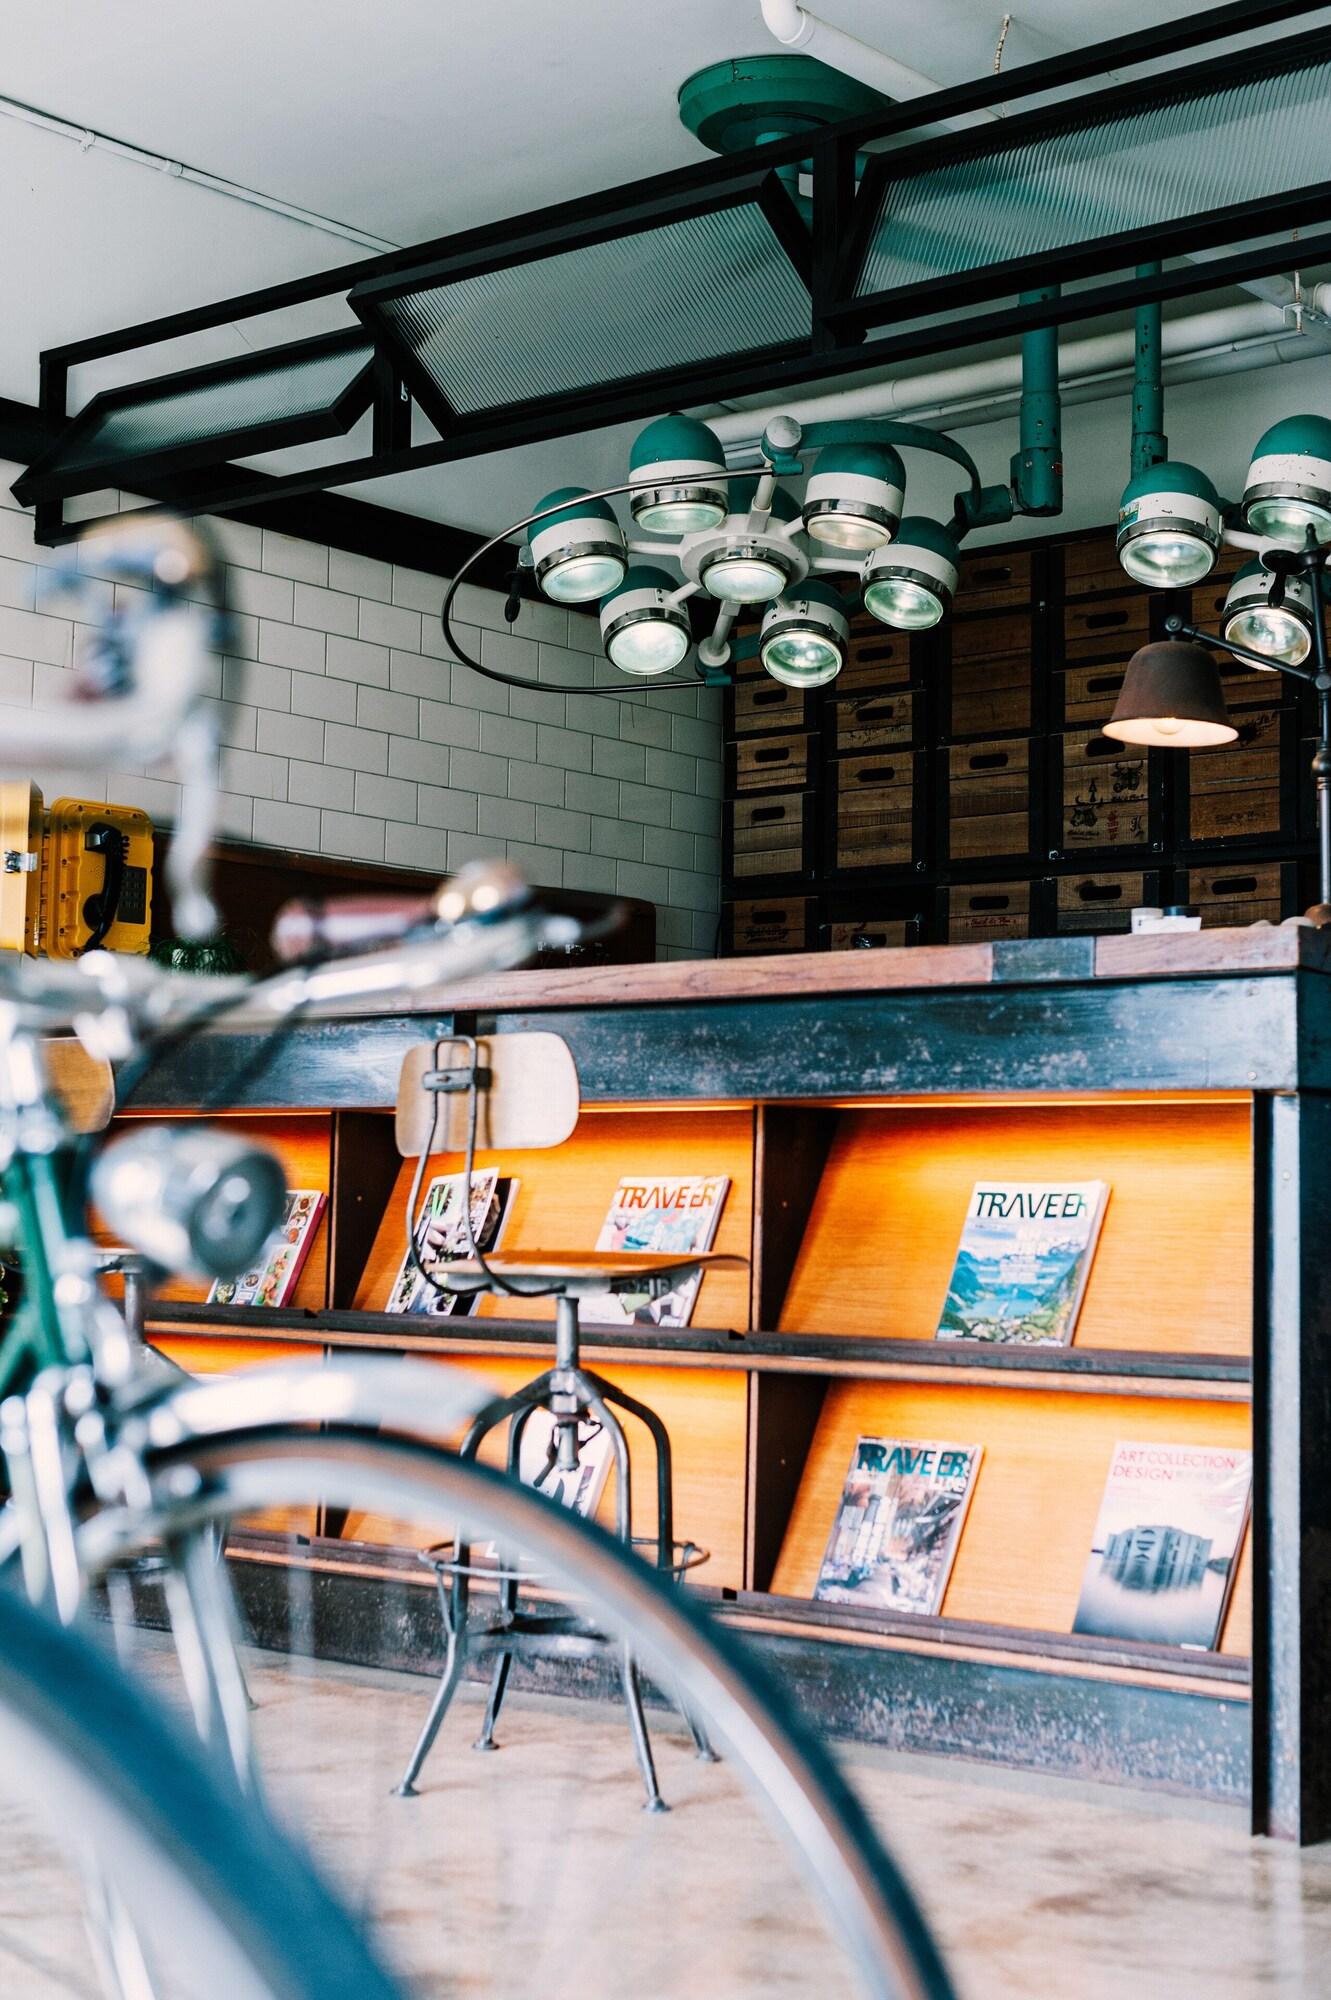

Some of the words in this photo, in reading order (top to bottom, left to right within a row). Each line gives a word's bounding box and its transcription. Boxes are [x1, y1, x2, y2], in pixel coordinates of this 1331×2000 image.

[1117, 1450, 1146, 1463] ART
[1148, 1452, 1237, 1469] COLLECTION
[1112, 1465, 1174, 1481] DESIGN
